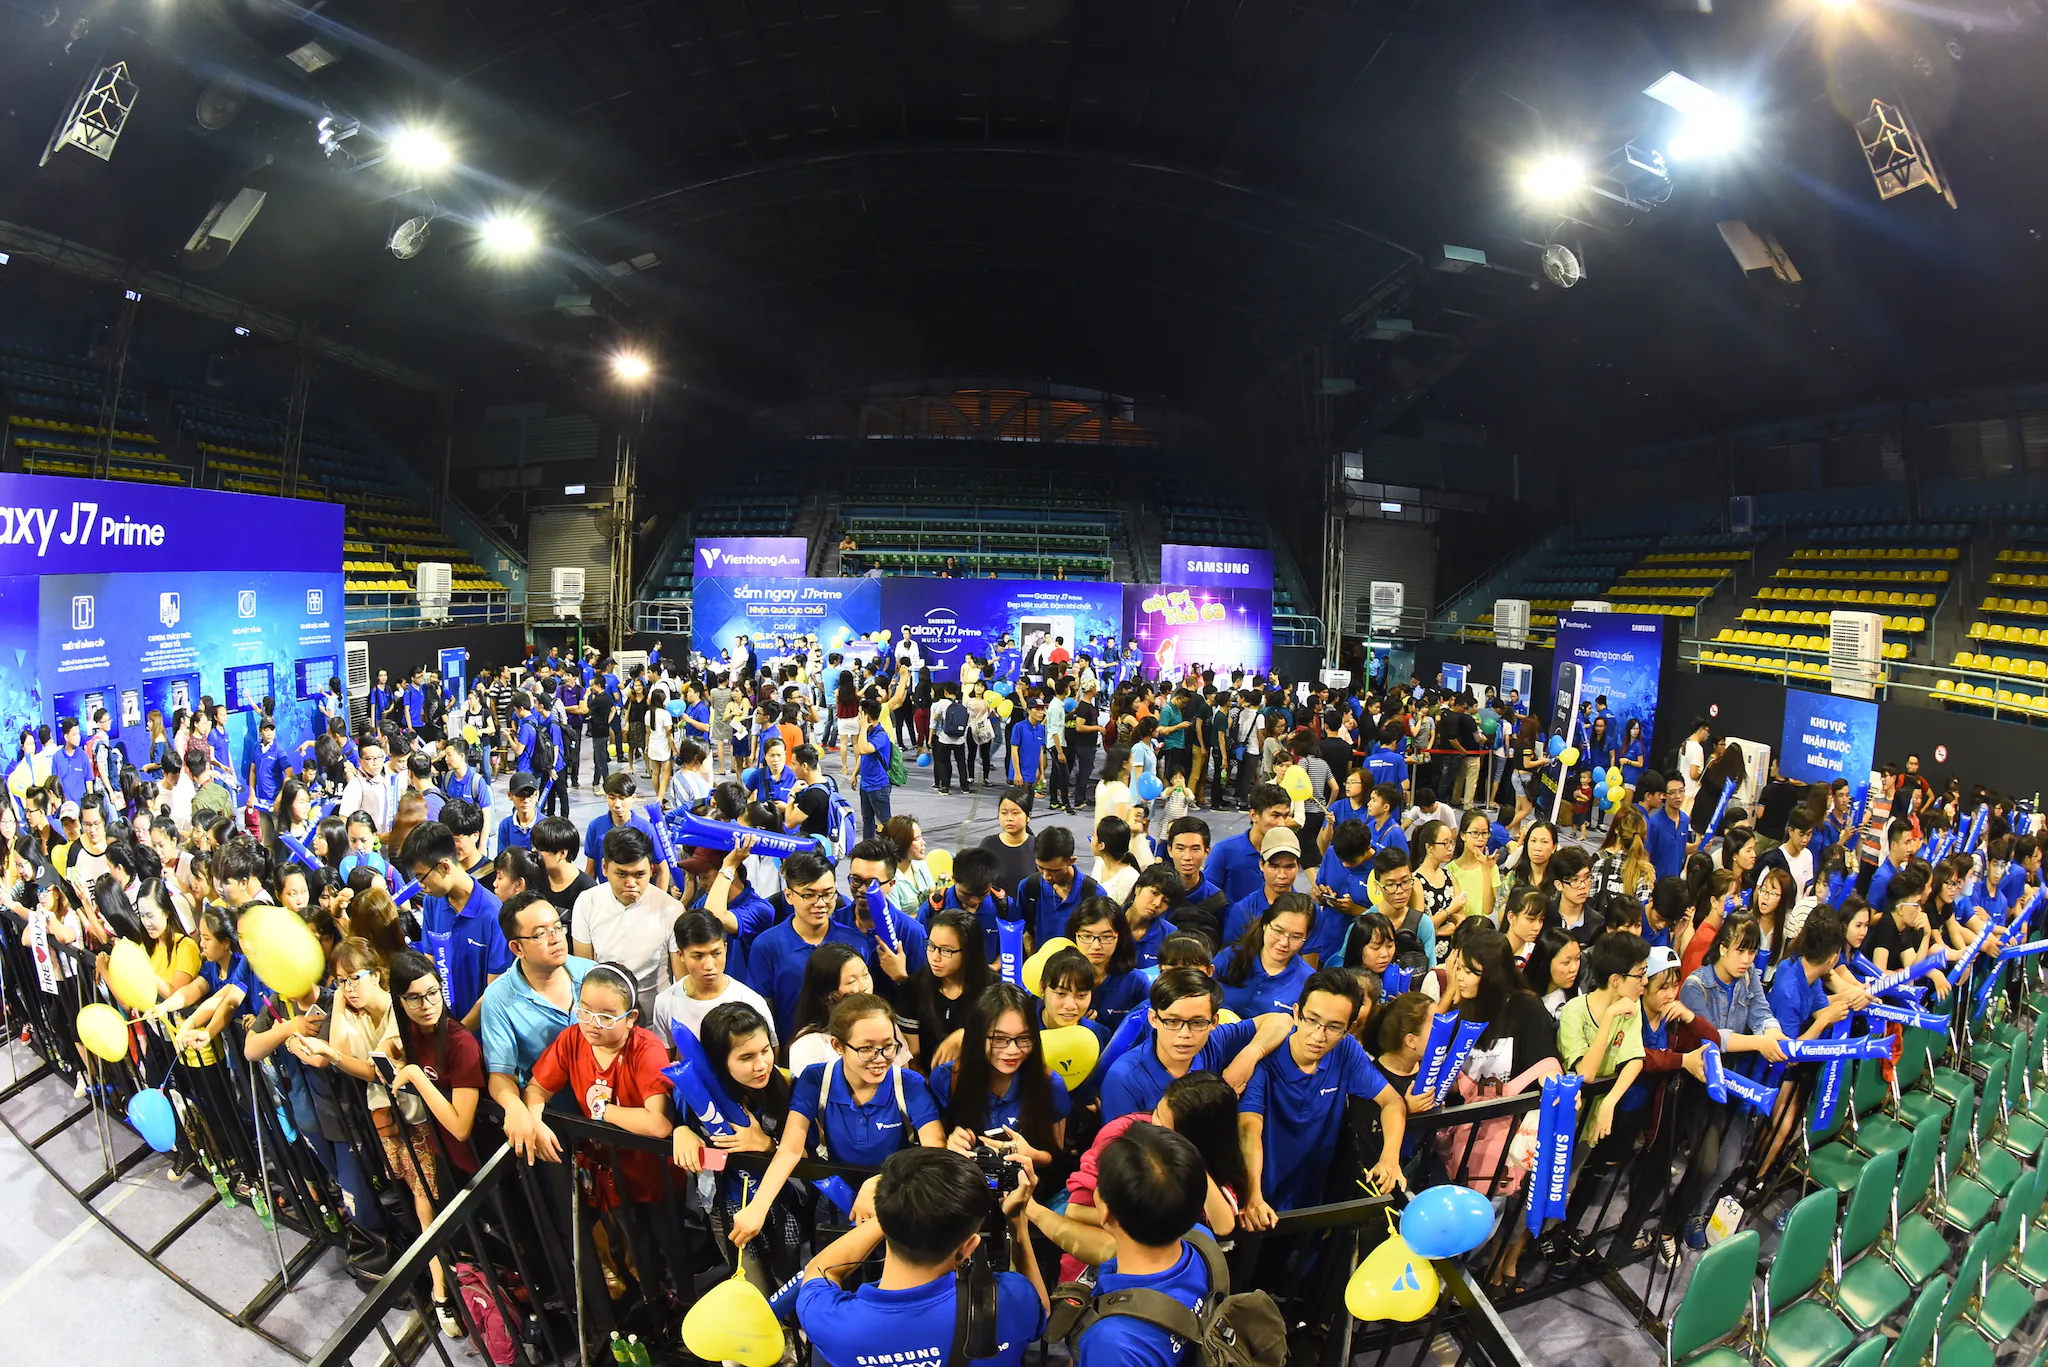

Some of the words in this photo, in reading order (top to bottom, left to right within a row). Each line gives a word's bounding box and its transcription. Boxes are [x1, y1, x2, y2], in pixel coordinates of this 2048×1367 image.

[60, 501, 99, 546] J7
[100, 514, 166, 547] Prime
[721, 553, 801, 567] VienthongA.vn
[1186, 560, 1251, 575] SAMSUNG
[764, 588, 799, 603] ngay
[944, 625, 958, 637] J7
[958, 629, 983, 637] Prime
[1631, 624, 1657, 633] SAMSUNG
[1581, 682, 1602, 698] alaxy
[1810, 716, 1829, 730] KHU
[1829, 720, 1848, 735] VỰC
[1802, 733, 1827, 749] NHẬN
[1826, 739, 1852, 754] NƯỚC
[1806, 752, 1828, 768] MIỄN
[437, 947, 452, 1009] enthongA.vn
[1801, 1044, 1858, 1056] VienthongA.vn
[1549, 1134, 1570, 1202] SAMSUNG
[856, 1346, 941, 1365] SAMSUNG
